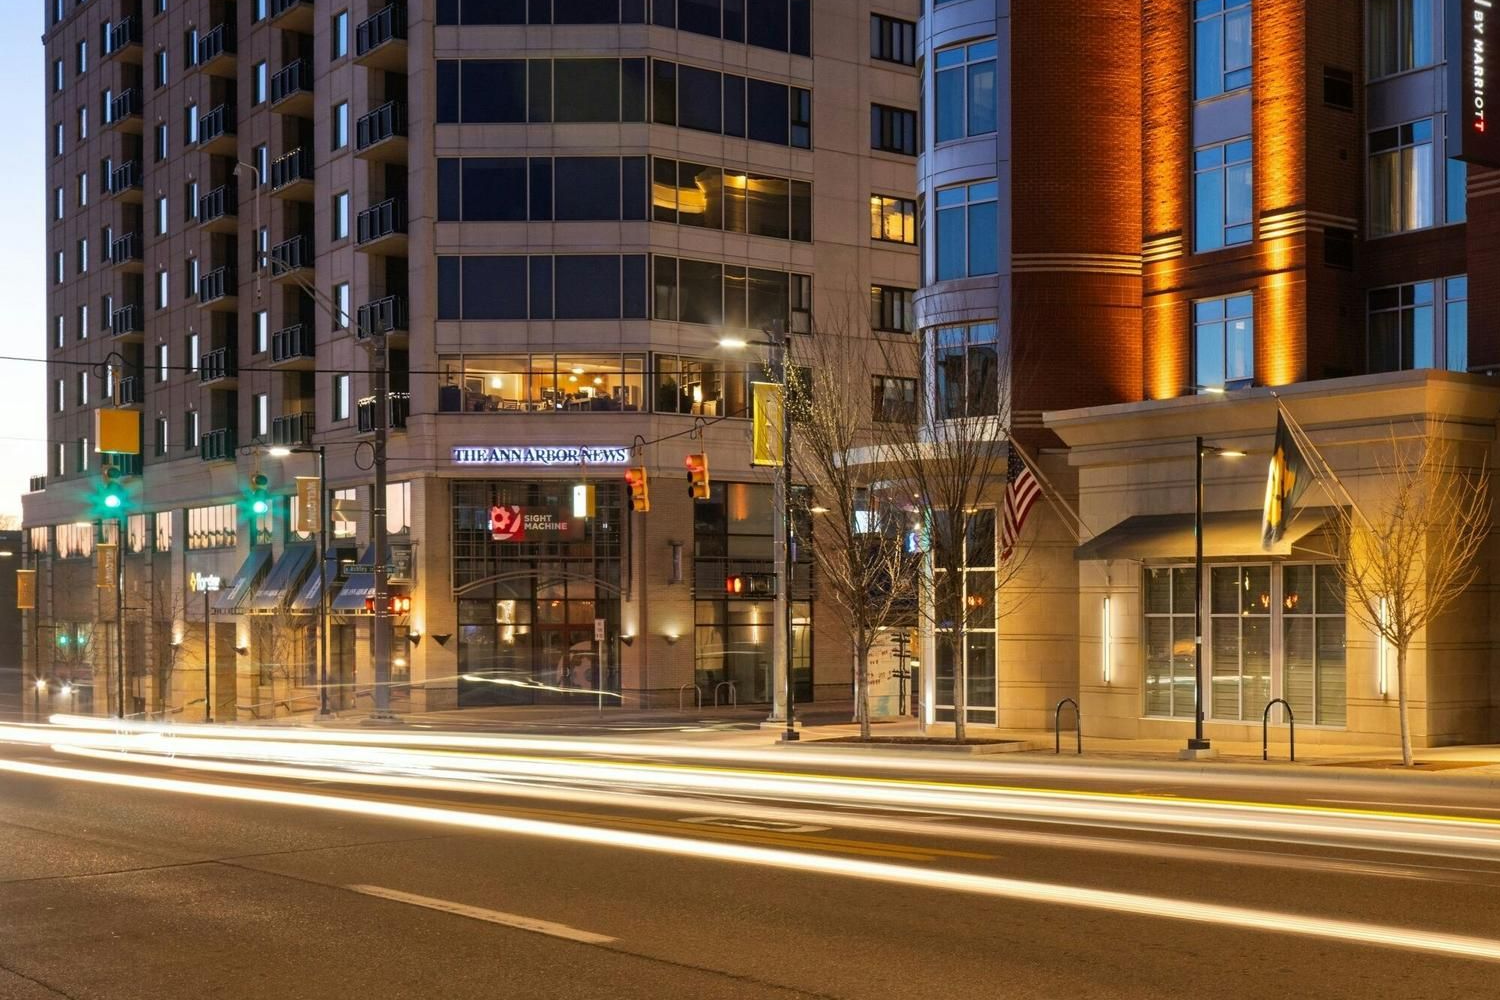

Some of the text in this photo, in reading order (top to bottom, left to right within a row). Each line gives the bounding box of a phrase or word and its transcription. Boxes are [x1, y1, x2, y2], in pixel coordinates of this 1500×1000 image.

[1474, 10, 1485, 34] BY
[1473, 38, 1485, 133] MARRIOTT
[454, 449, 627, 465] THE ANN ARBOR NEWS
[524, 522, 567, 530] MACHINE
